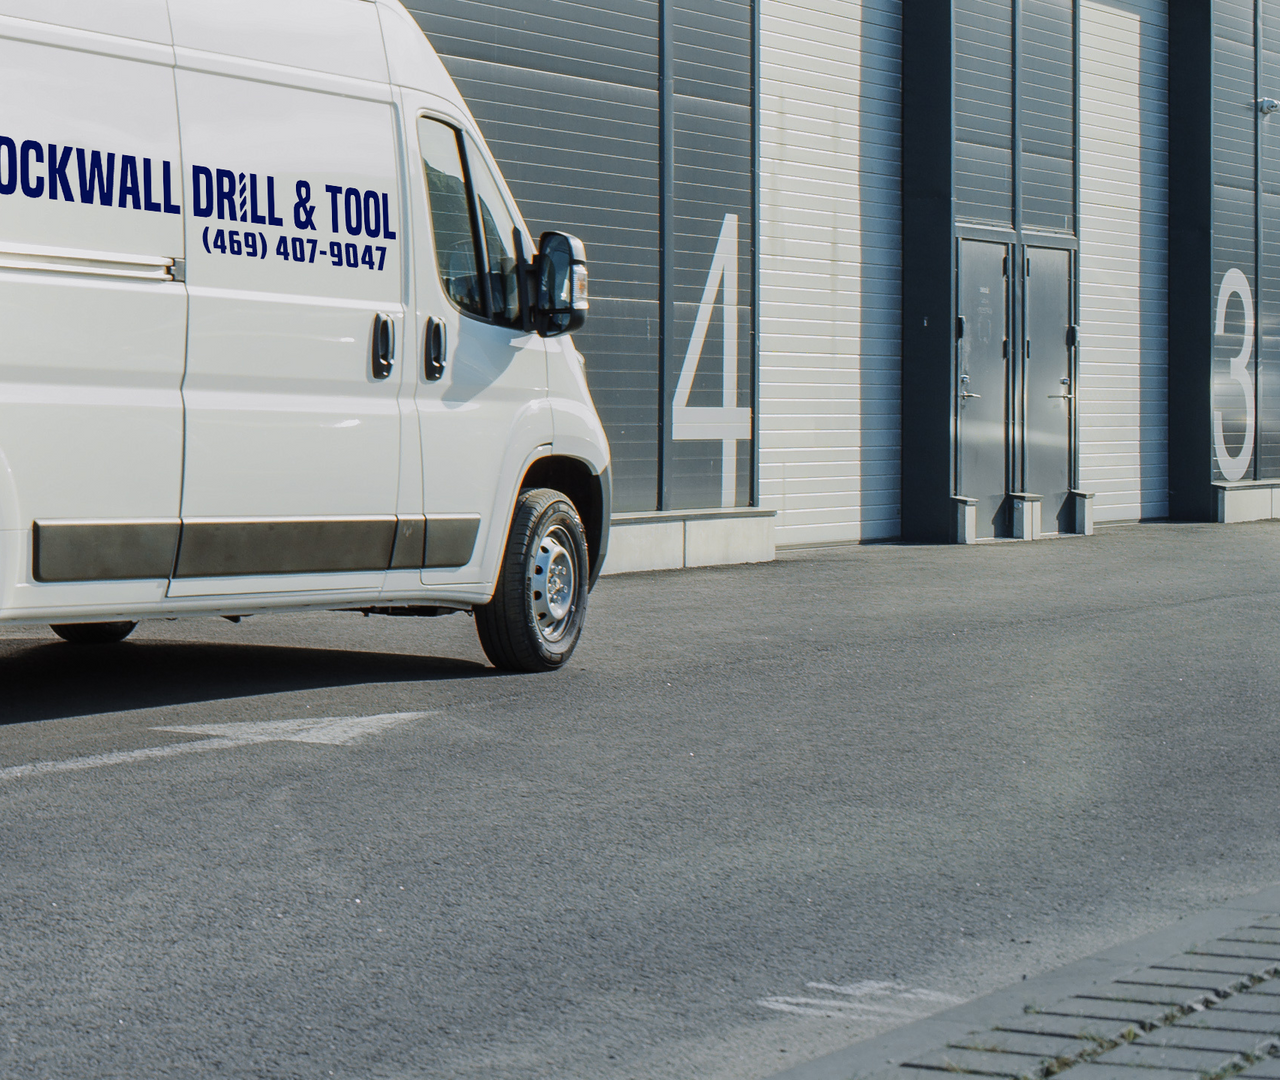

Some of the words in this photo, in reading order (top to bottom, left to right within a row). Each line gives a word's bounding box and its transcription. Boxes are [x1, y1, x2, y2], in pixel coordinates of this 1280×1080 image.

[192, 165, 283, 227] DRILL
[294, 180, 317, 231] &
[326, 184, 397, 240] TOOL
[202, 226, 268, 260] (469)
[276, 235, 387, 271] 407-9047
[672, 213, 752, 508] 4
[1214, 268, 1256, 481] 3
